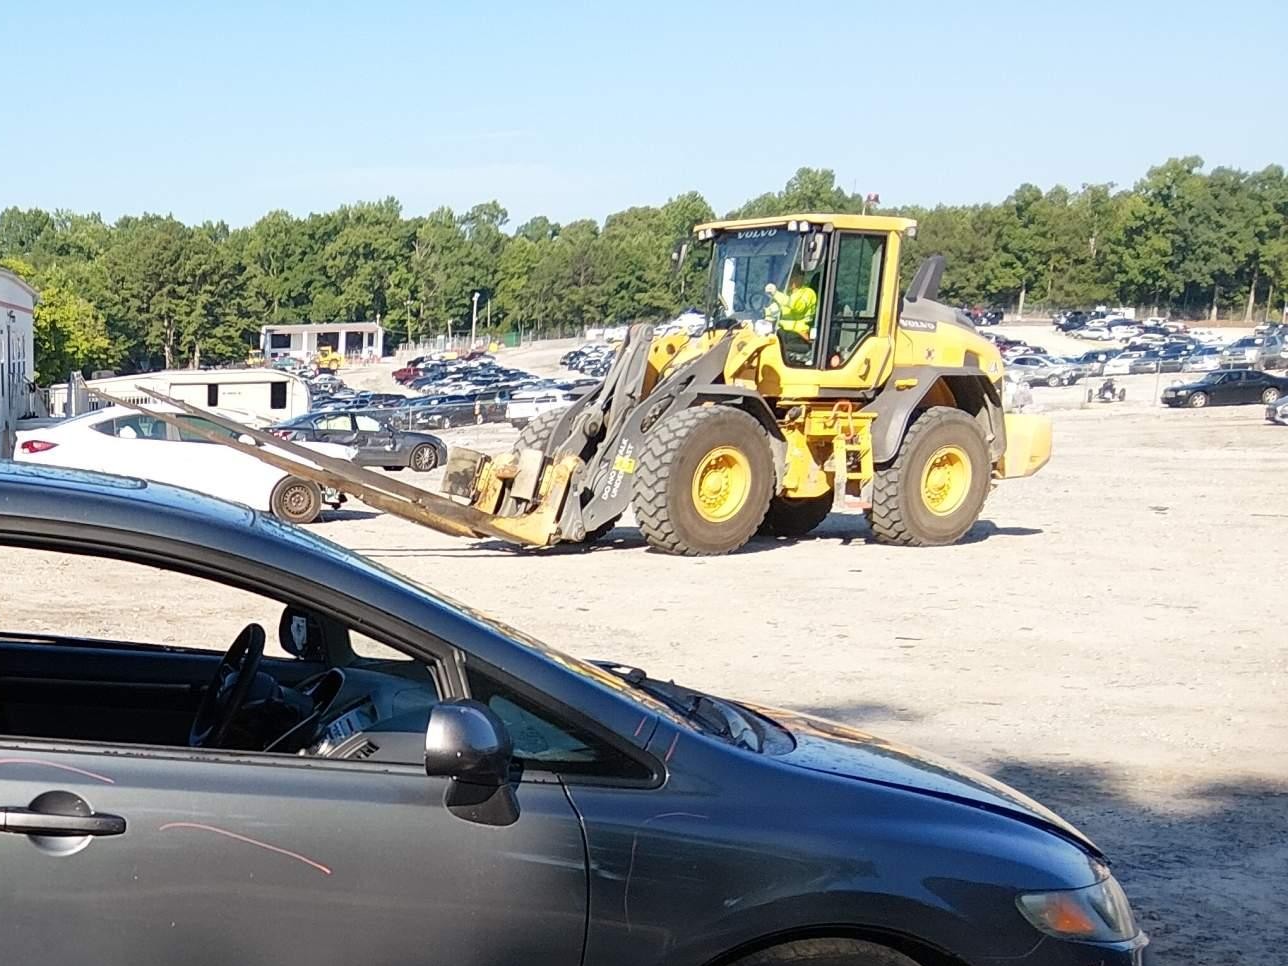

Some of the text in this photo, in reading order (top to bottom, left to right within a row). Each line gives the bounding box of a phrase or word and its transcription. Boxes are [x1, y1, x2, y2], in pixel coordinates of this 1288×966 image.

[737, 229, 777, 239] VOLVO
[899, 319, 936, 330] VOLVO
[601, 485, 611, 500] DO
